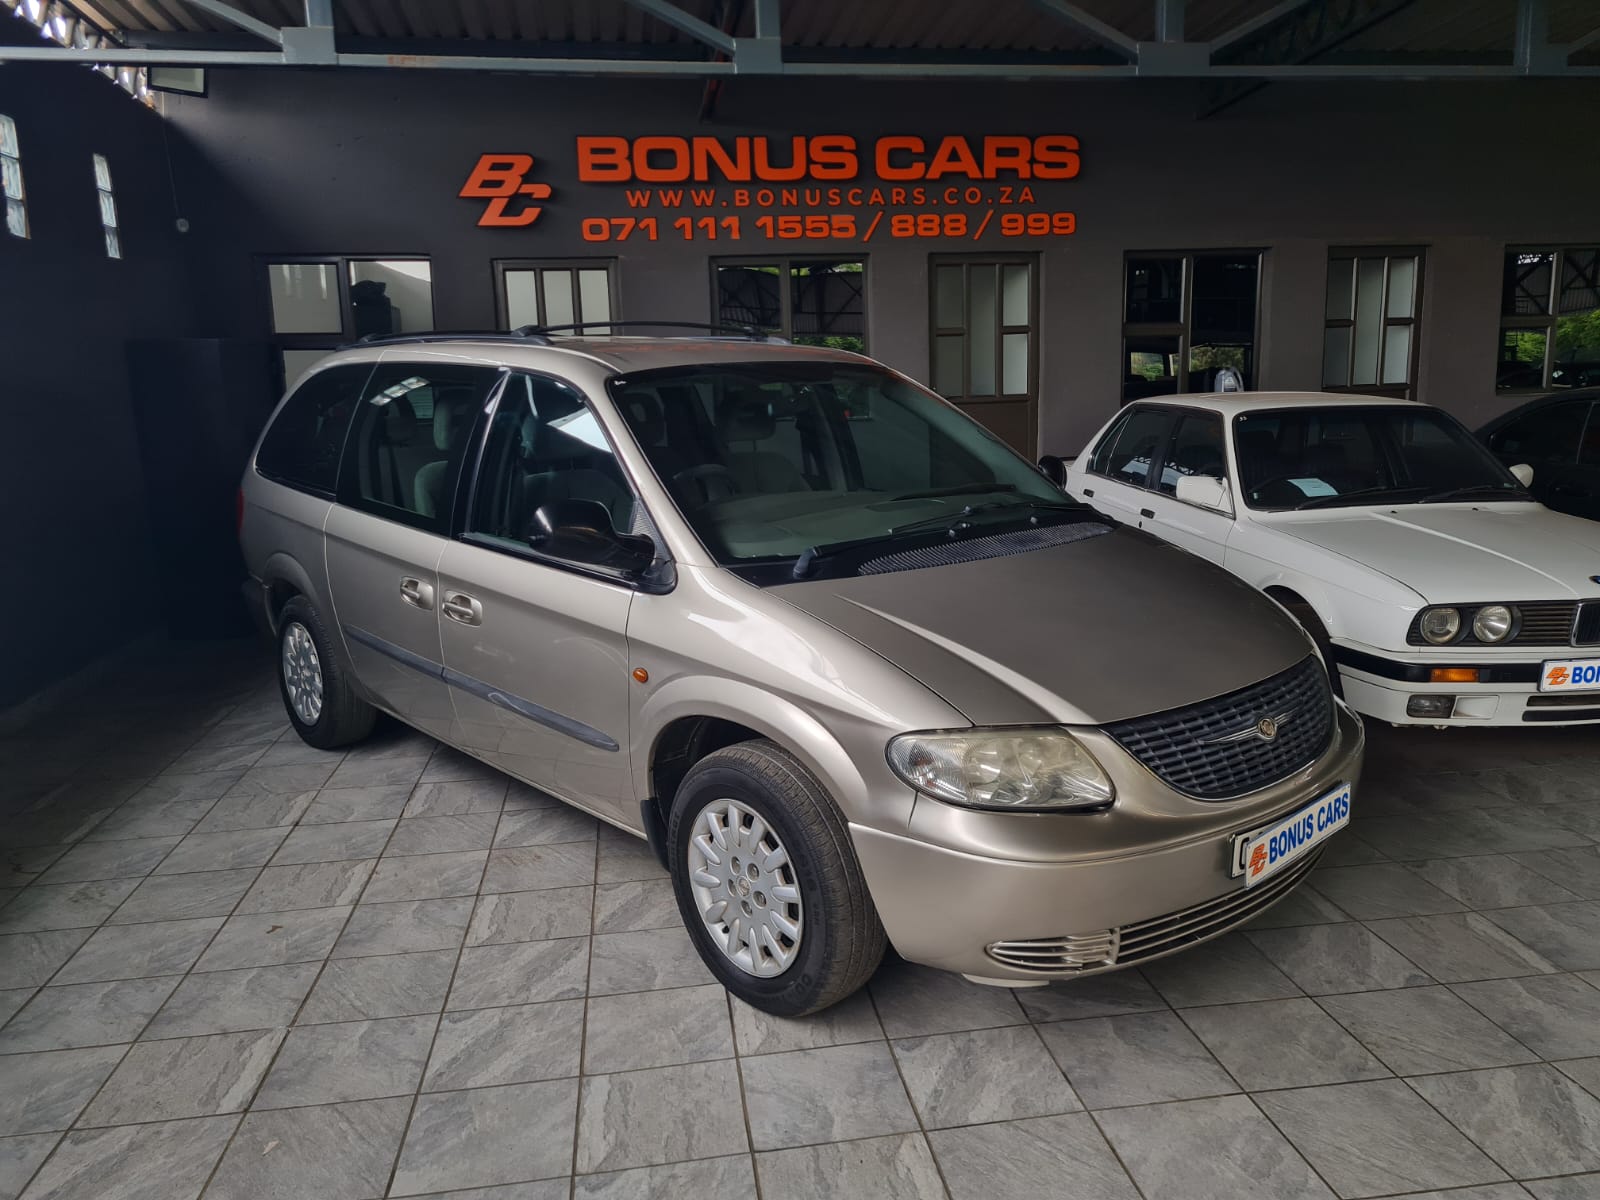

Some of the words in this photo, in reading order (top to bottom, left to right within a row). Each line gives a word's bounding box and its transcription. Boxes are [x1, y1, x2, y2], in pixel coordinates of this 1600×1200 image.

[576, 135, 858, 182] BONUS
[875, 135, 1080, 181] CARS
[625, 187, 1036, 208] WWW.BONUSCARS.CO.ZA
[581, 217, 658, 242] 071
[673, 216, 741, 241] 111
[1571, 665, 1600, 684] BO
[1269, 813, 1314, 864] BONUS
[1317, 792, 1349, 832] CARS
